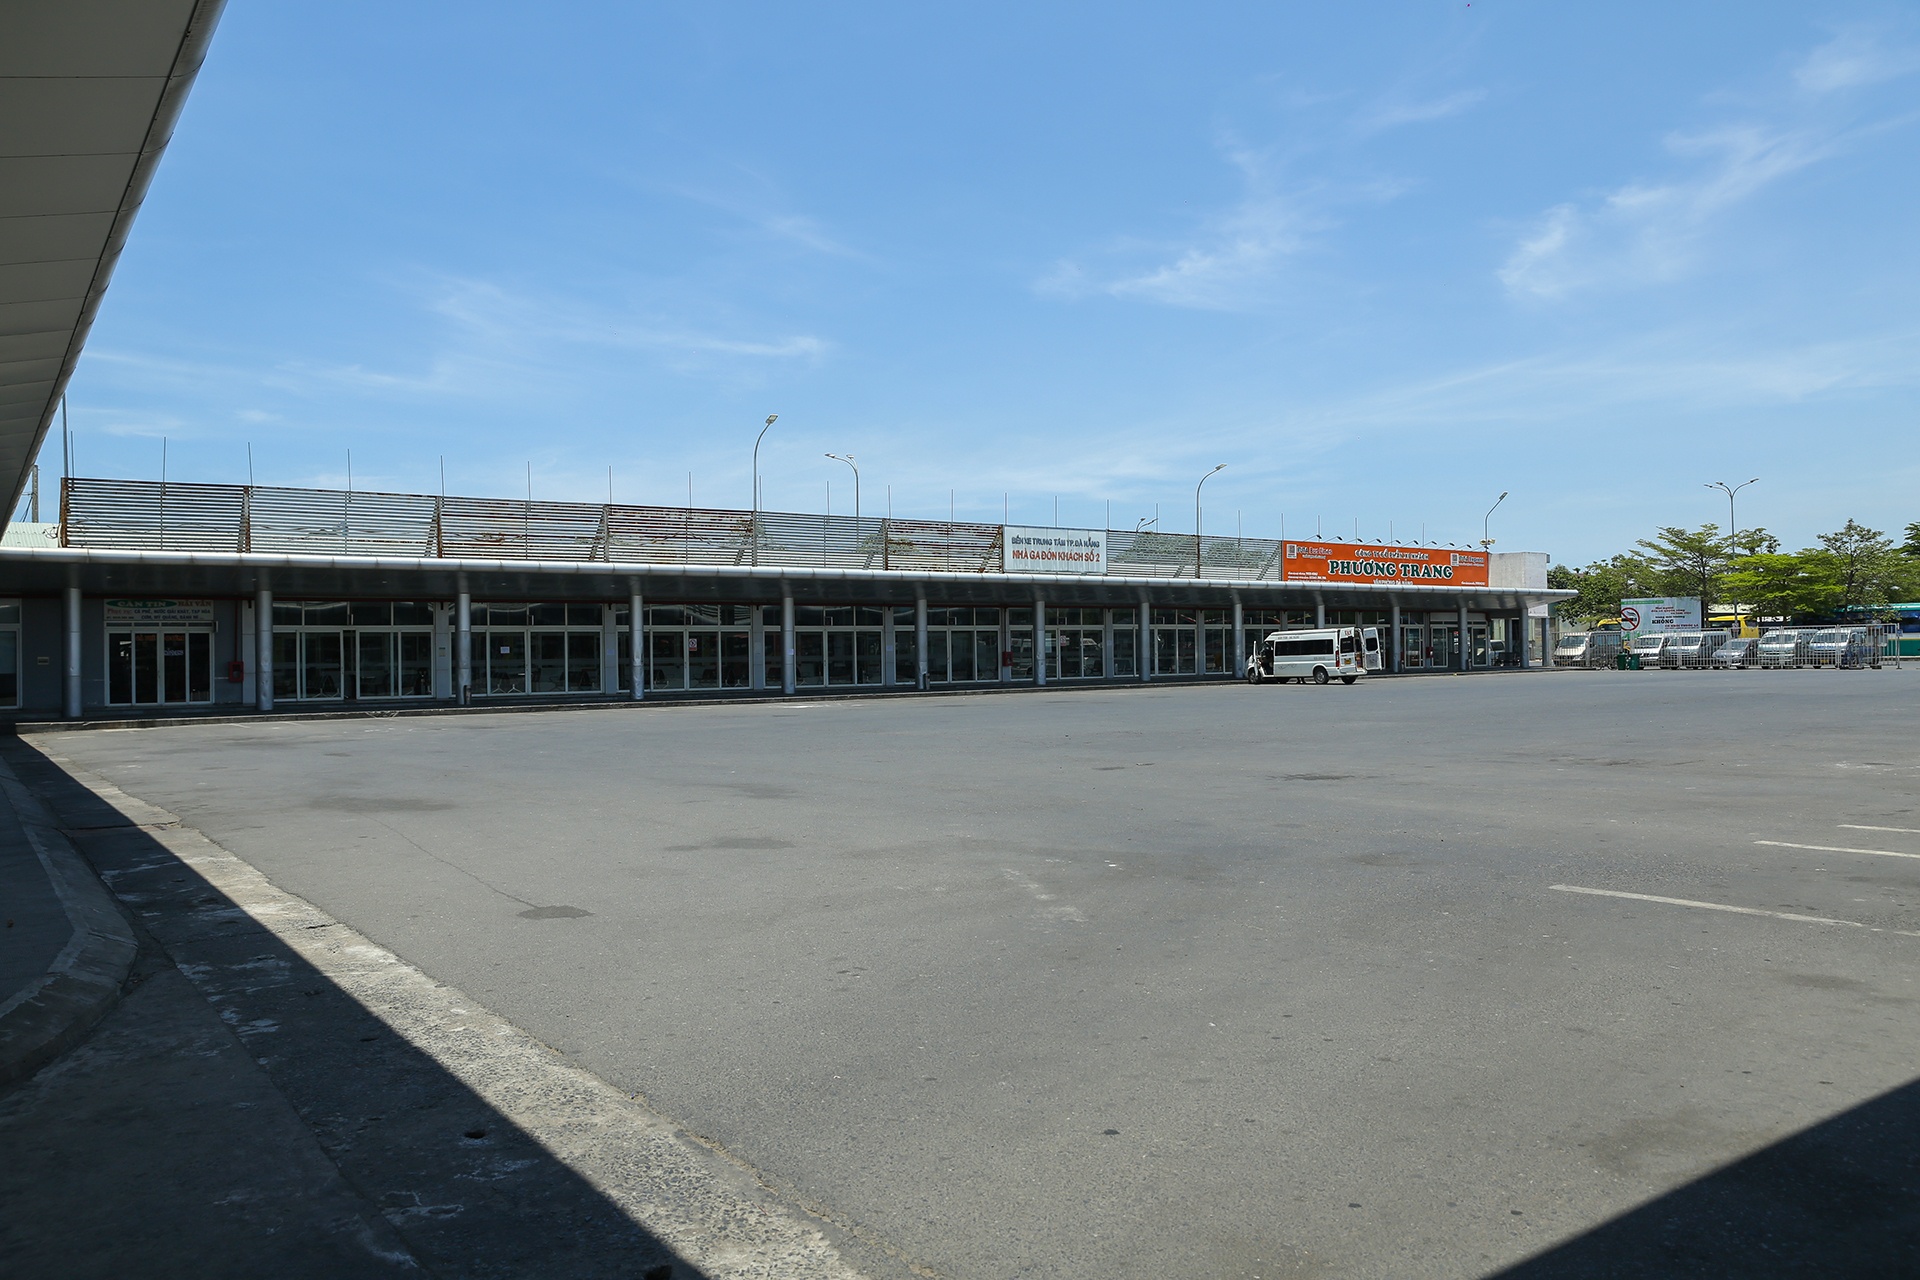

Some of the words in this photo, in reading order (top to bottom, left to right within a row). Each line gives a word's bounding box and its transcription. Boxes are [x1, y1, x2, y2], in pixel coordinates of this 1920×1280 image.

[1024, 537, 1032, 545] XE
[1032, 537, 1053, 546] TRUNG
[1012, 548, 1029, 560] NHÀ
[1029, 550, 1041, 560] GA
[1041, 548, 1057, 560] ĐÓN
[1058, 549, 1084, 562] KHÁCH
[1084, 548, 1095, 562] SỐ
[1095, 553, 1100, 562] 2
[1328, 559, 1397, 577] PHƯƠNG
[1399, 562, 1453, 580] TRANG
